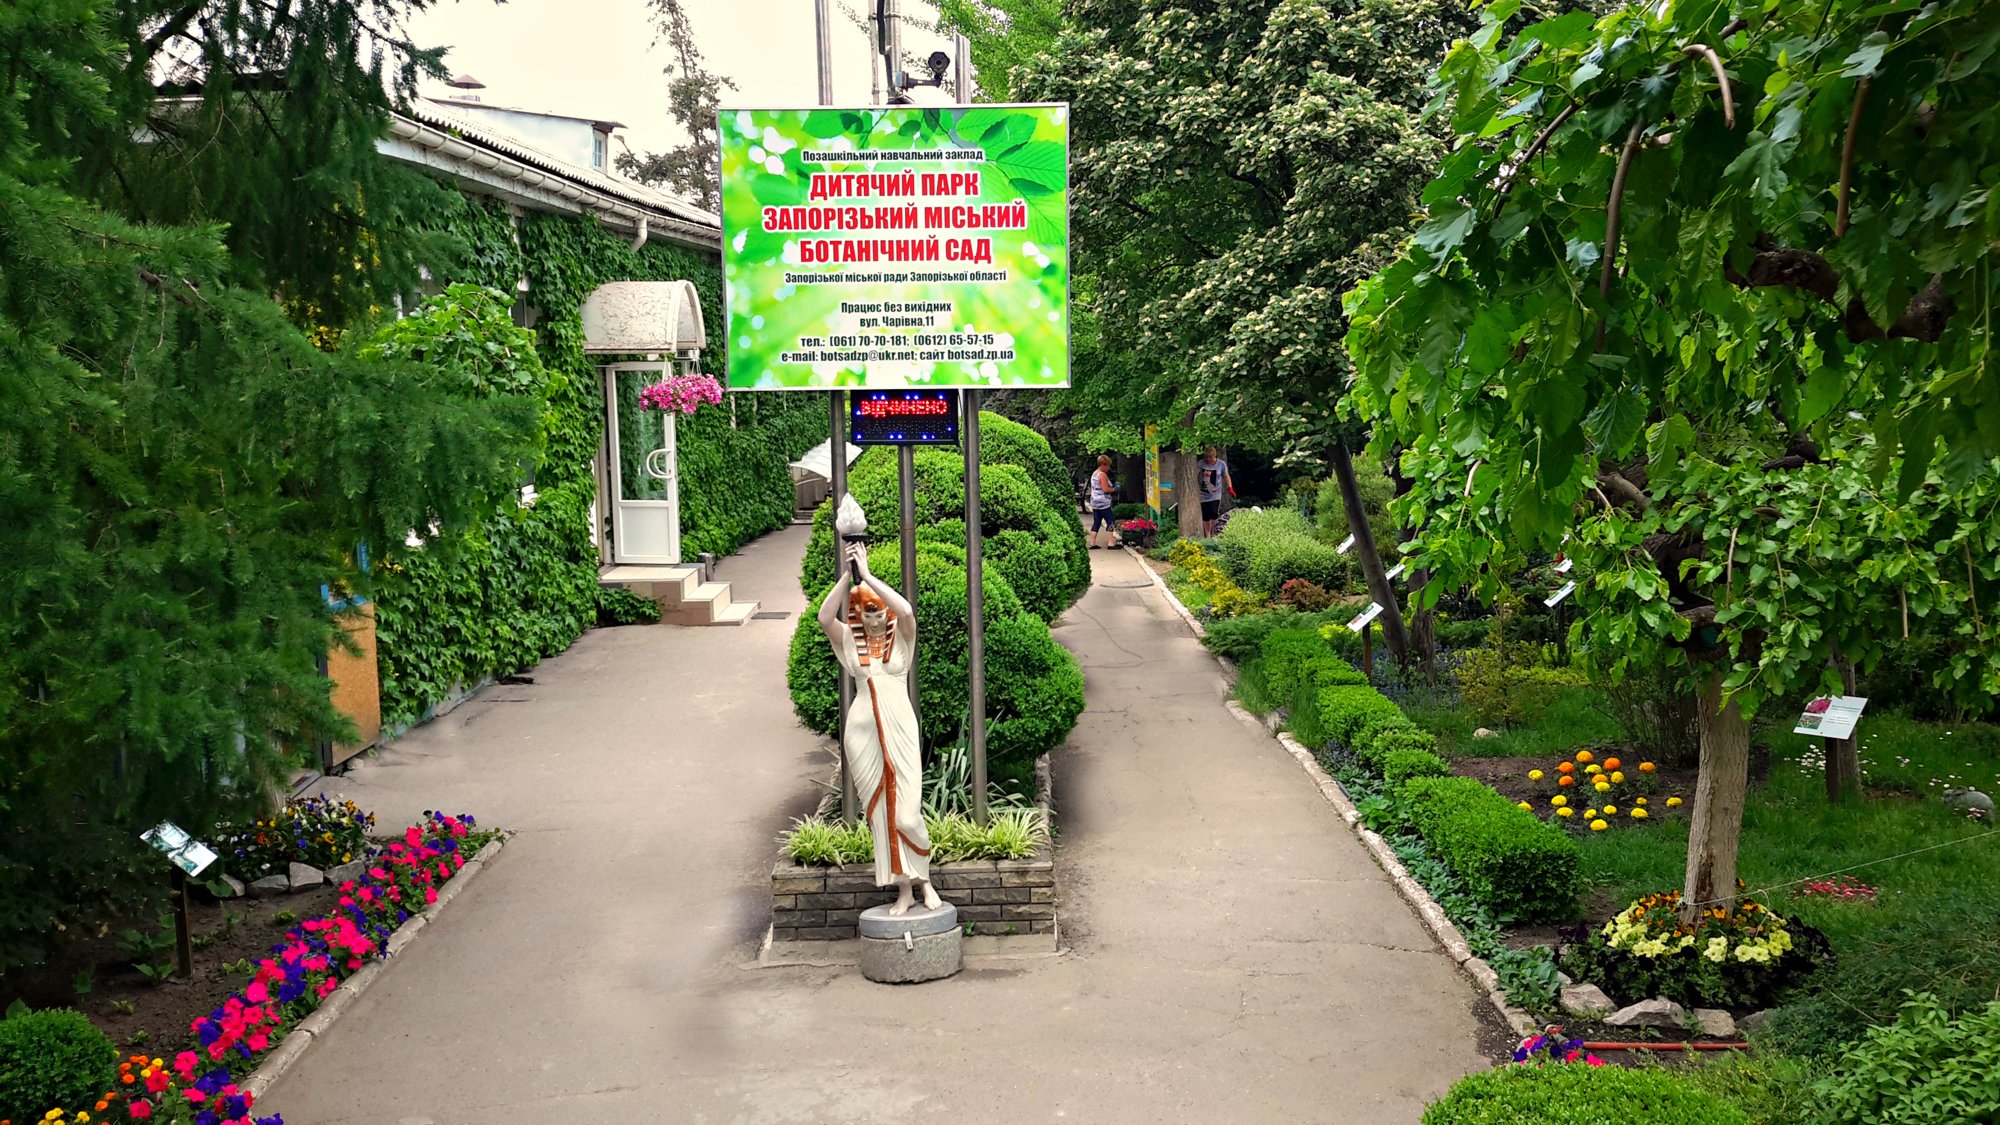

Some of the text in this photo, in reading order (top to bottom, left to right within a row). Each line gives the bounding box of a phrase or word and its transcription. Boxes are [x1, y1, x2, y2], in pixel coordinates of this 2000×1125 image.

[803, 150, 983, 162] Позашкільний навчальний заклад
[810, 170, 978, 200] ДИТЯЧИЙ ПАРК
[764, 201, 1026, 230] ЗАПОРІЗЬКИЙ МІСЬКИЙ
[800, 235, 991, 264] БОТАНІЧНИЙ САД
[785, 271, 1006, 283] Запорізької міської ради Запорізької області
[841, 301, 951, 314] Працює без вихідних
[860, 317, 880, 328] вул.
[801, 334, 993, 347] тел.: (061) 70-70-181; (0612) 65-57-15
[782, 350, 1013, 362] e-mail: botsadzp@ukr.net; сайт botsad.zp.ua
[860, 400, 947, 417] ВІДЧИНЕНО
